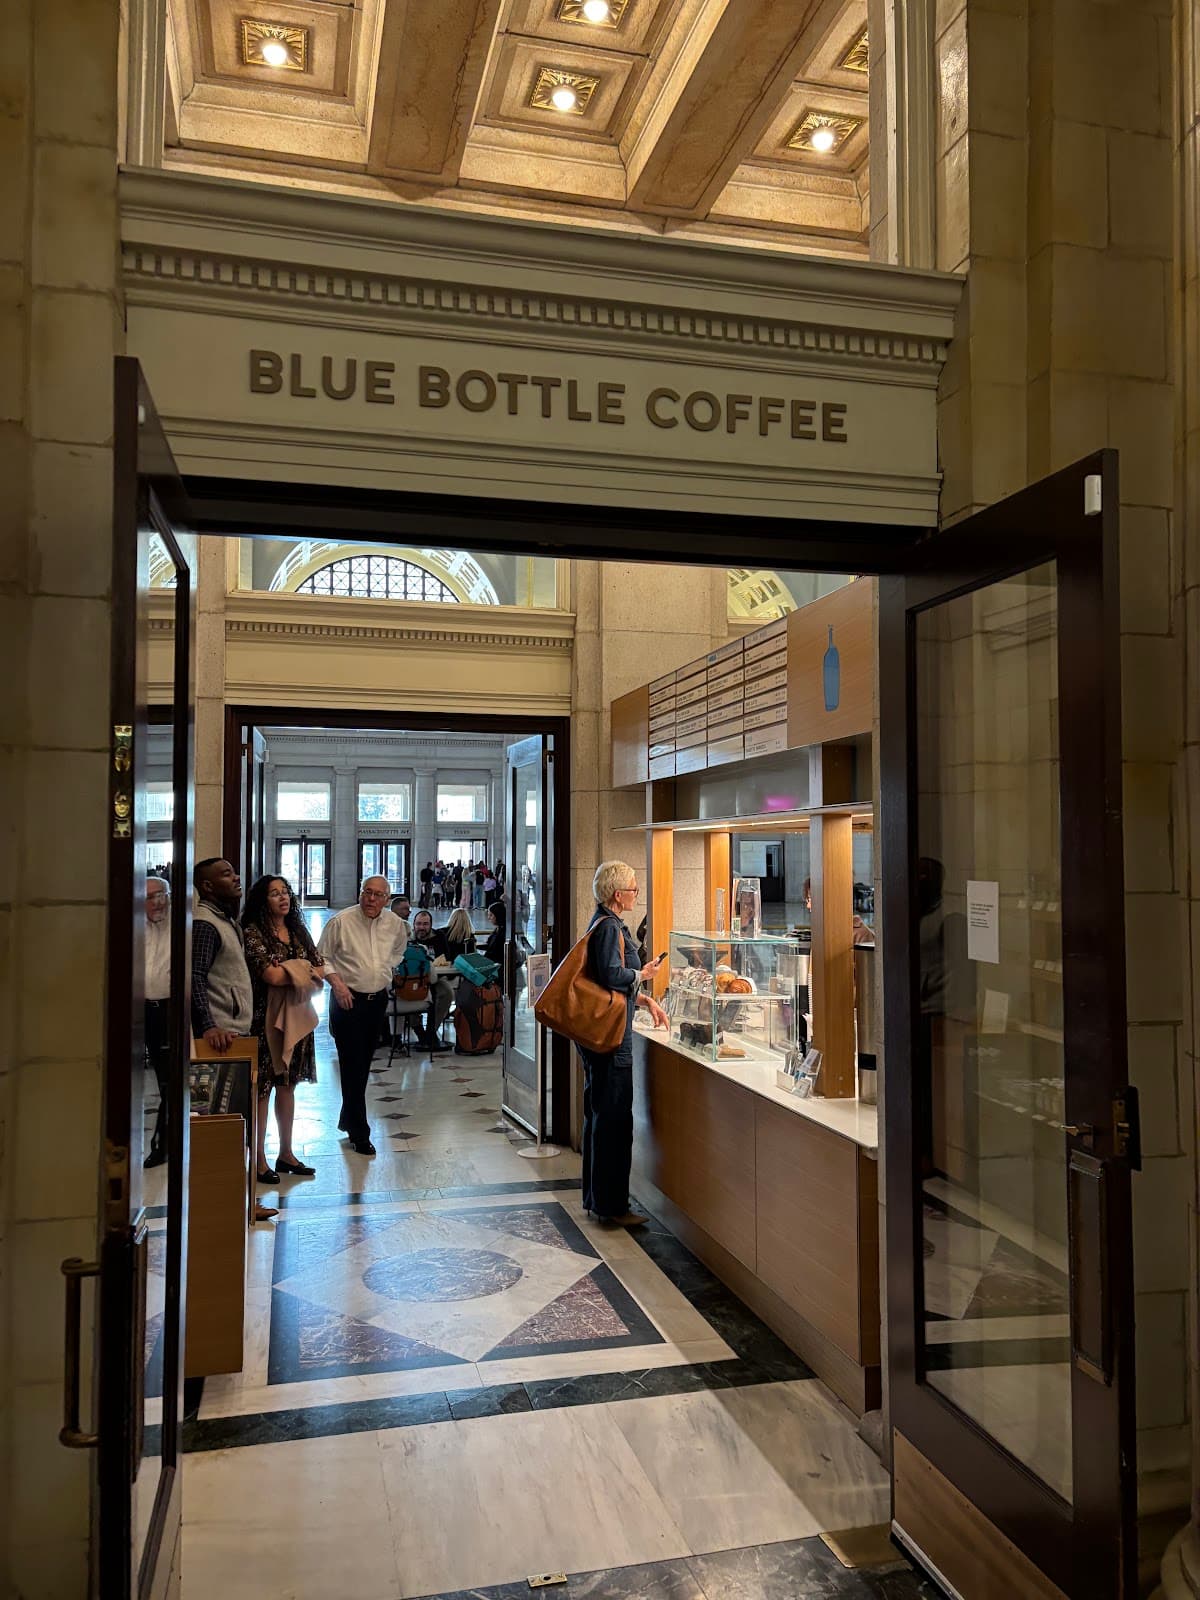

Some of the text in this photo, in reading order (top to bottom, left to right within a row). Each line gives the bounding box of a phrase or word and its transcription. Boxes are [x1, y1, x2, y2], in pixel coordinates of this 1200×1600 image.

[250, 349, 848, 443] BLUE BOTTLE COFFEE
